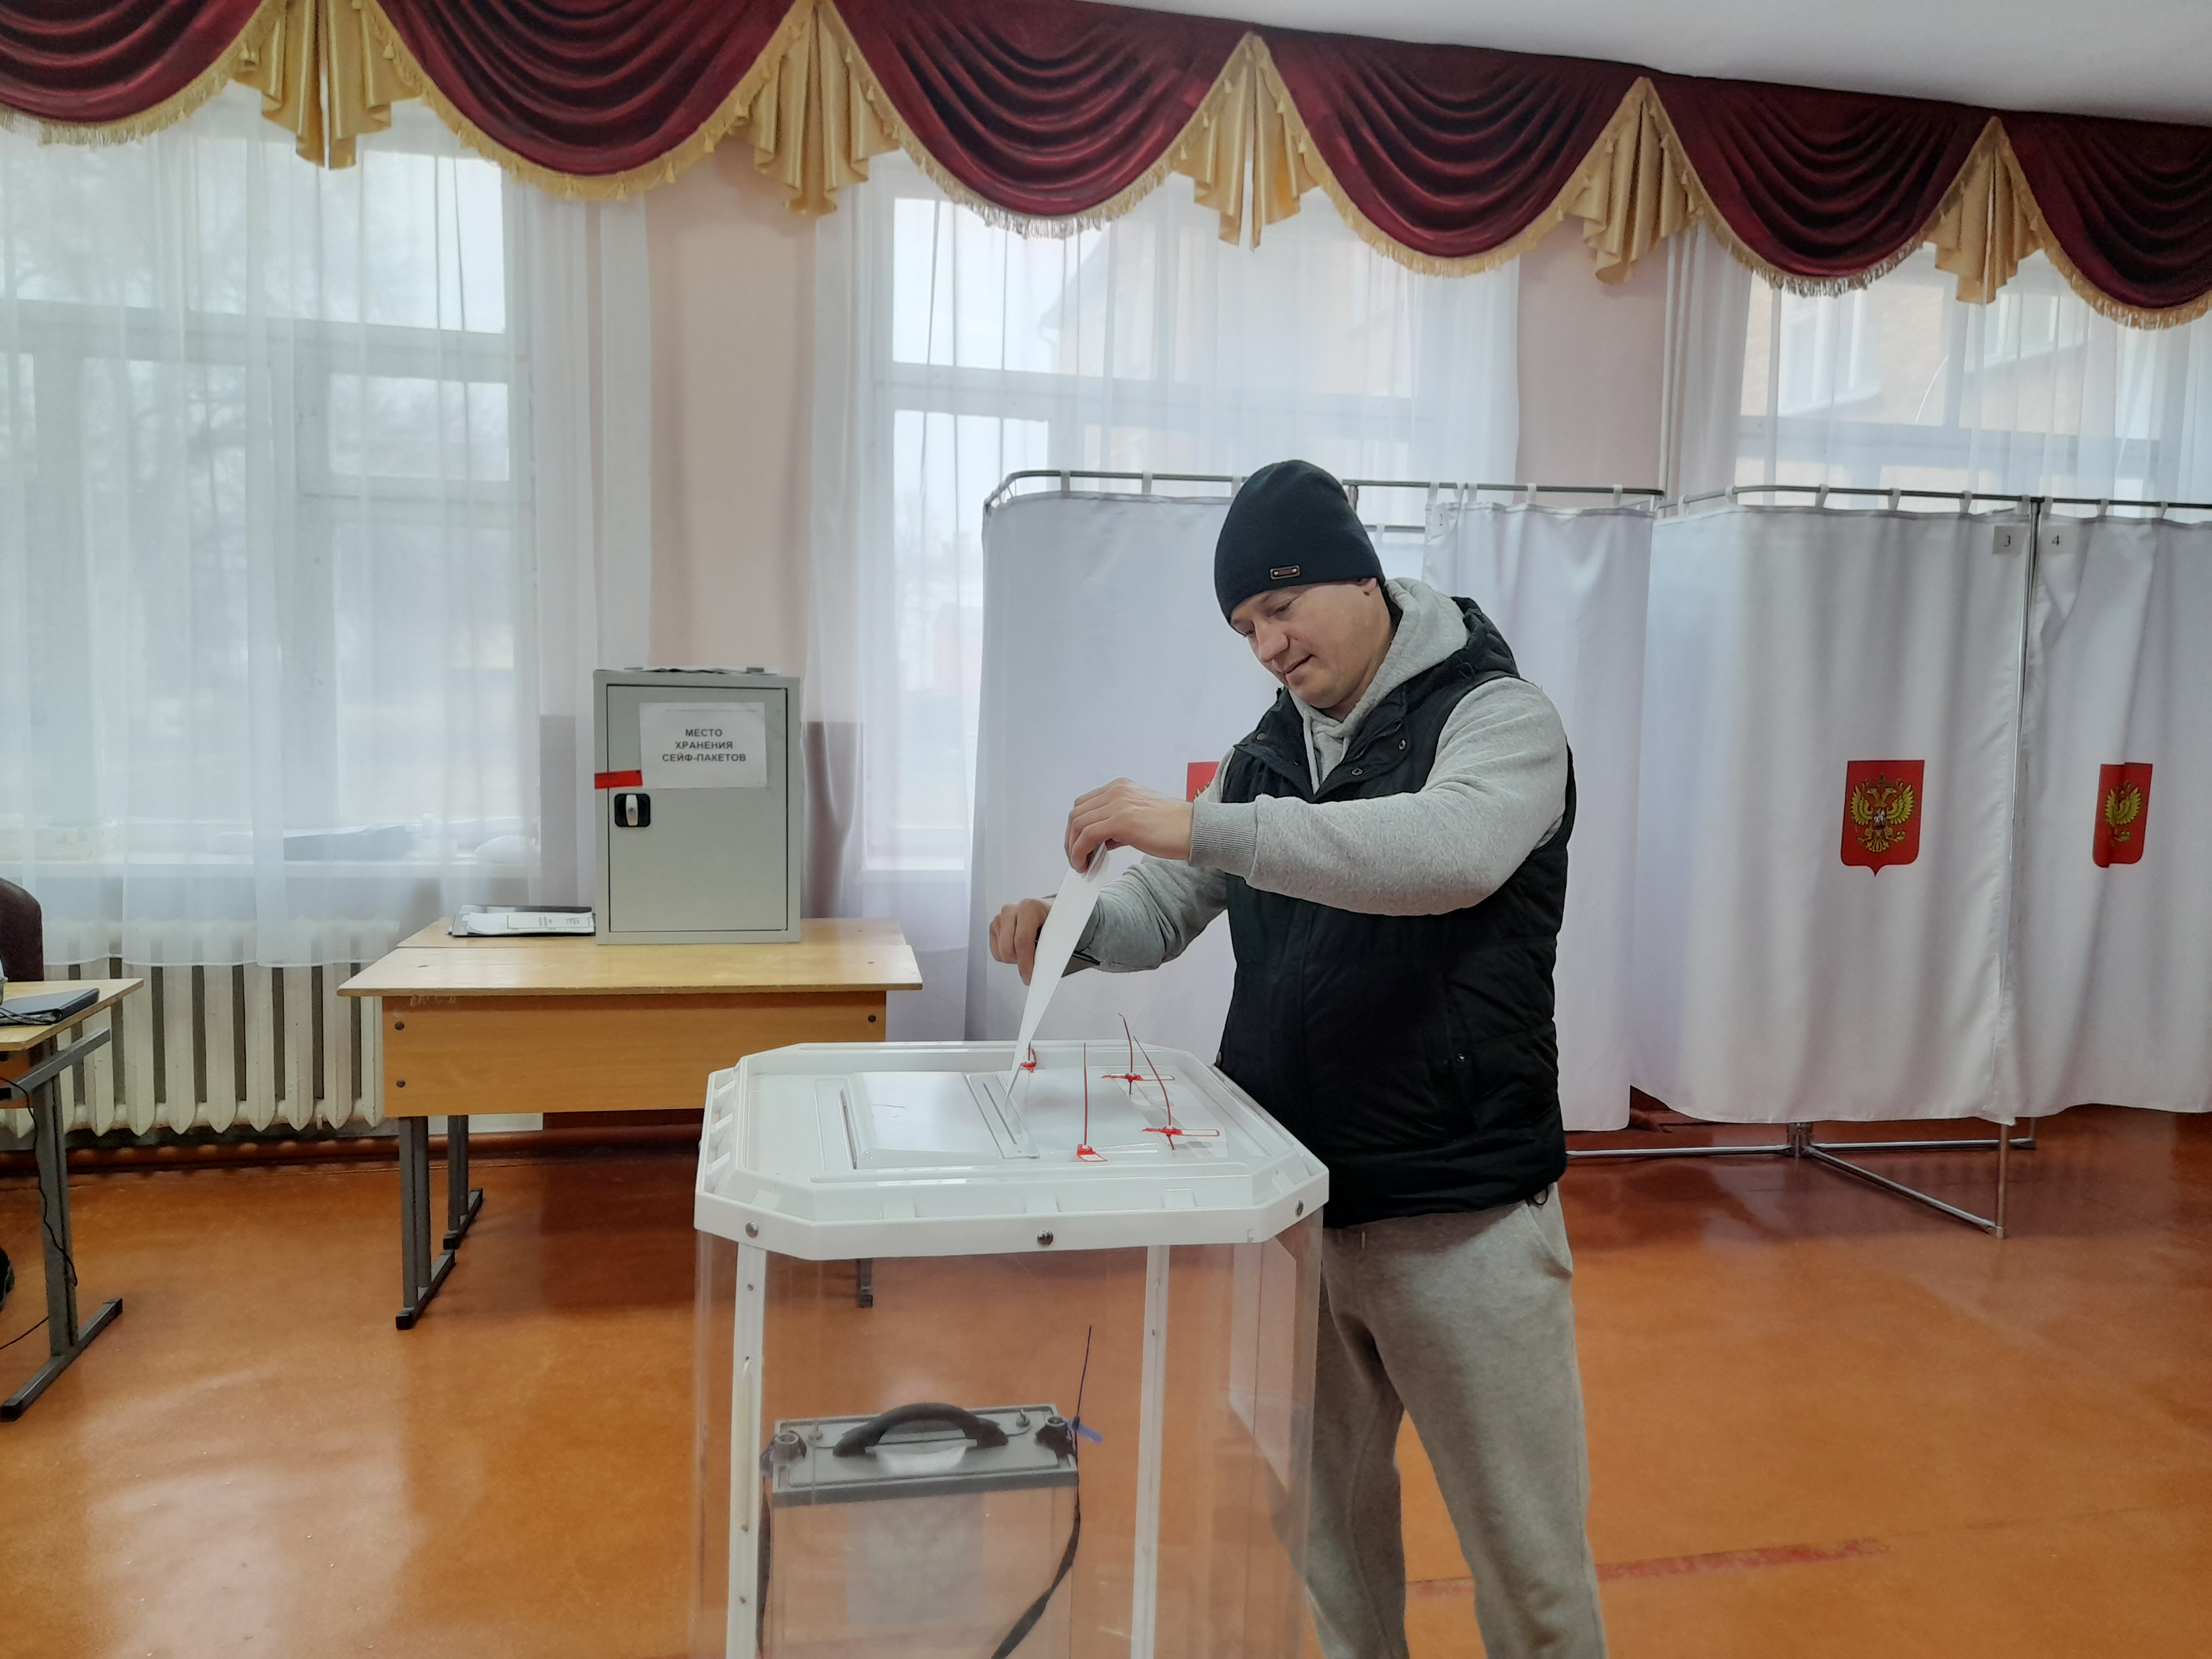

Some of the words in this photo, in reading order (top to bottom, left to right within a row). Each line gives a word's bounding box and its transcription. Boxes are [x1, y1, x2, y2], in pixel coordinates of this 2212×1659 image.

[2004, 535, 2011, 547] 3
[2051, 535, 2060, 546] 4
[685, 728, 723, 737] МЕСТО
[675, 741, 733, 749] ХРАНЕНИЯ
[662, 753, 746, 762] СЕЙФ-ПАКЕТОВ
